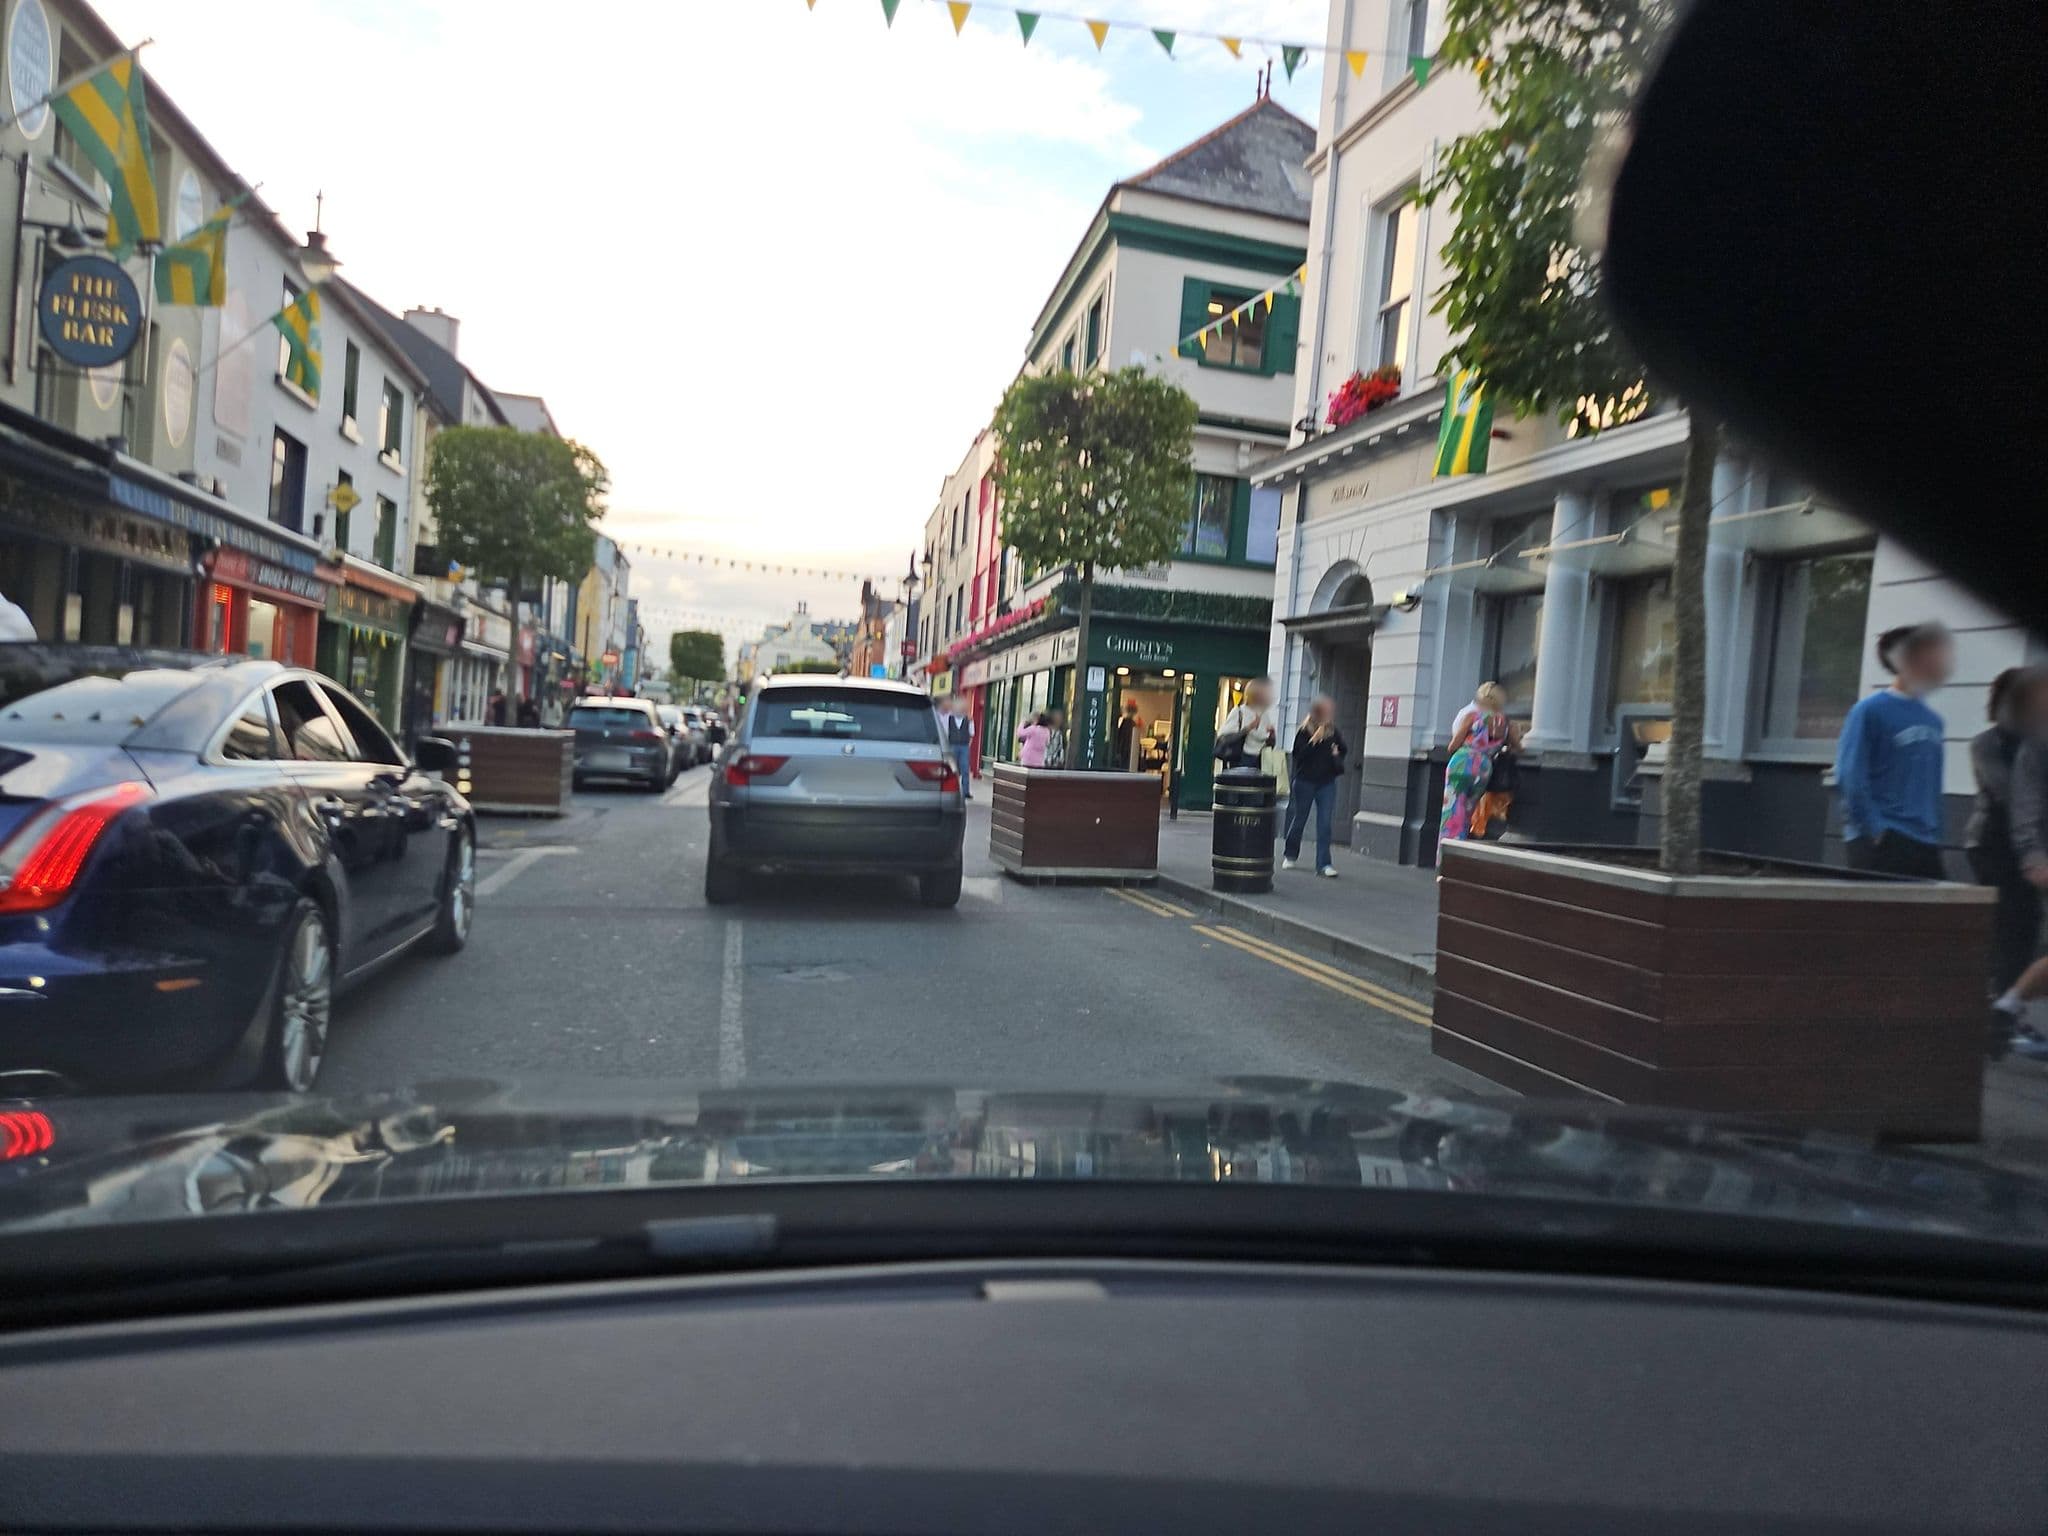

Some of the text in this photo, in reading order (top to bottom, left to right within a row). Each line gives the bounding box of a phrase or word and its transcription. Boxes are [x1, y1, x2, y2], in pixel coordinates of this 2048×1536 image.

[71, 272, 118, 299] THE
[52, 293, 129, 326] FLESK
[63, 320, 114, 347] BAR
